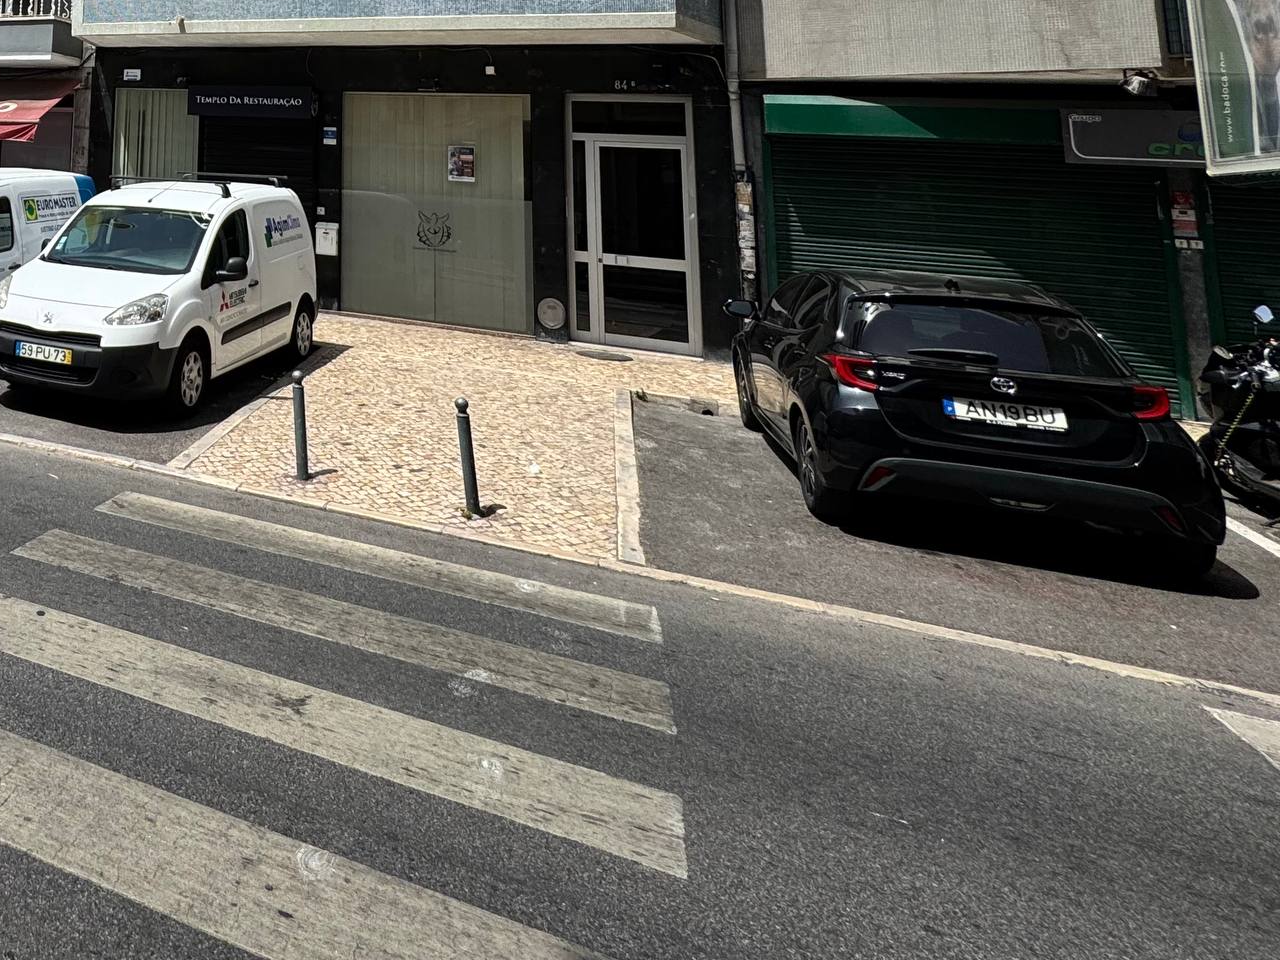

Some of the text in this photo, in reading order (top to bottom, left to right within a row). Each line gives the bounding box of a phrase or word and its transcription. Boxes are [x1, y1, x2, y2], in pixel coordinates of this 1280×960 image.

[195, 95, 227, 104] TEMPLO
[229, 96, 242, 104] DA
[36, 197, 77, 211] EUROMASTER
